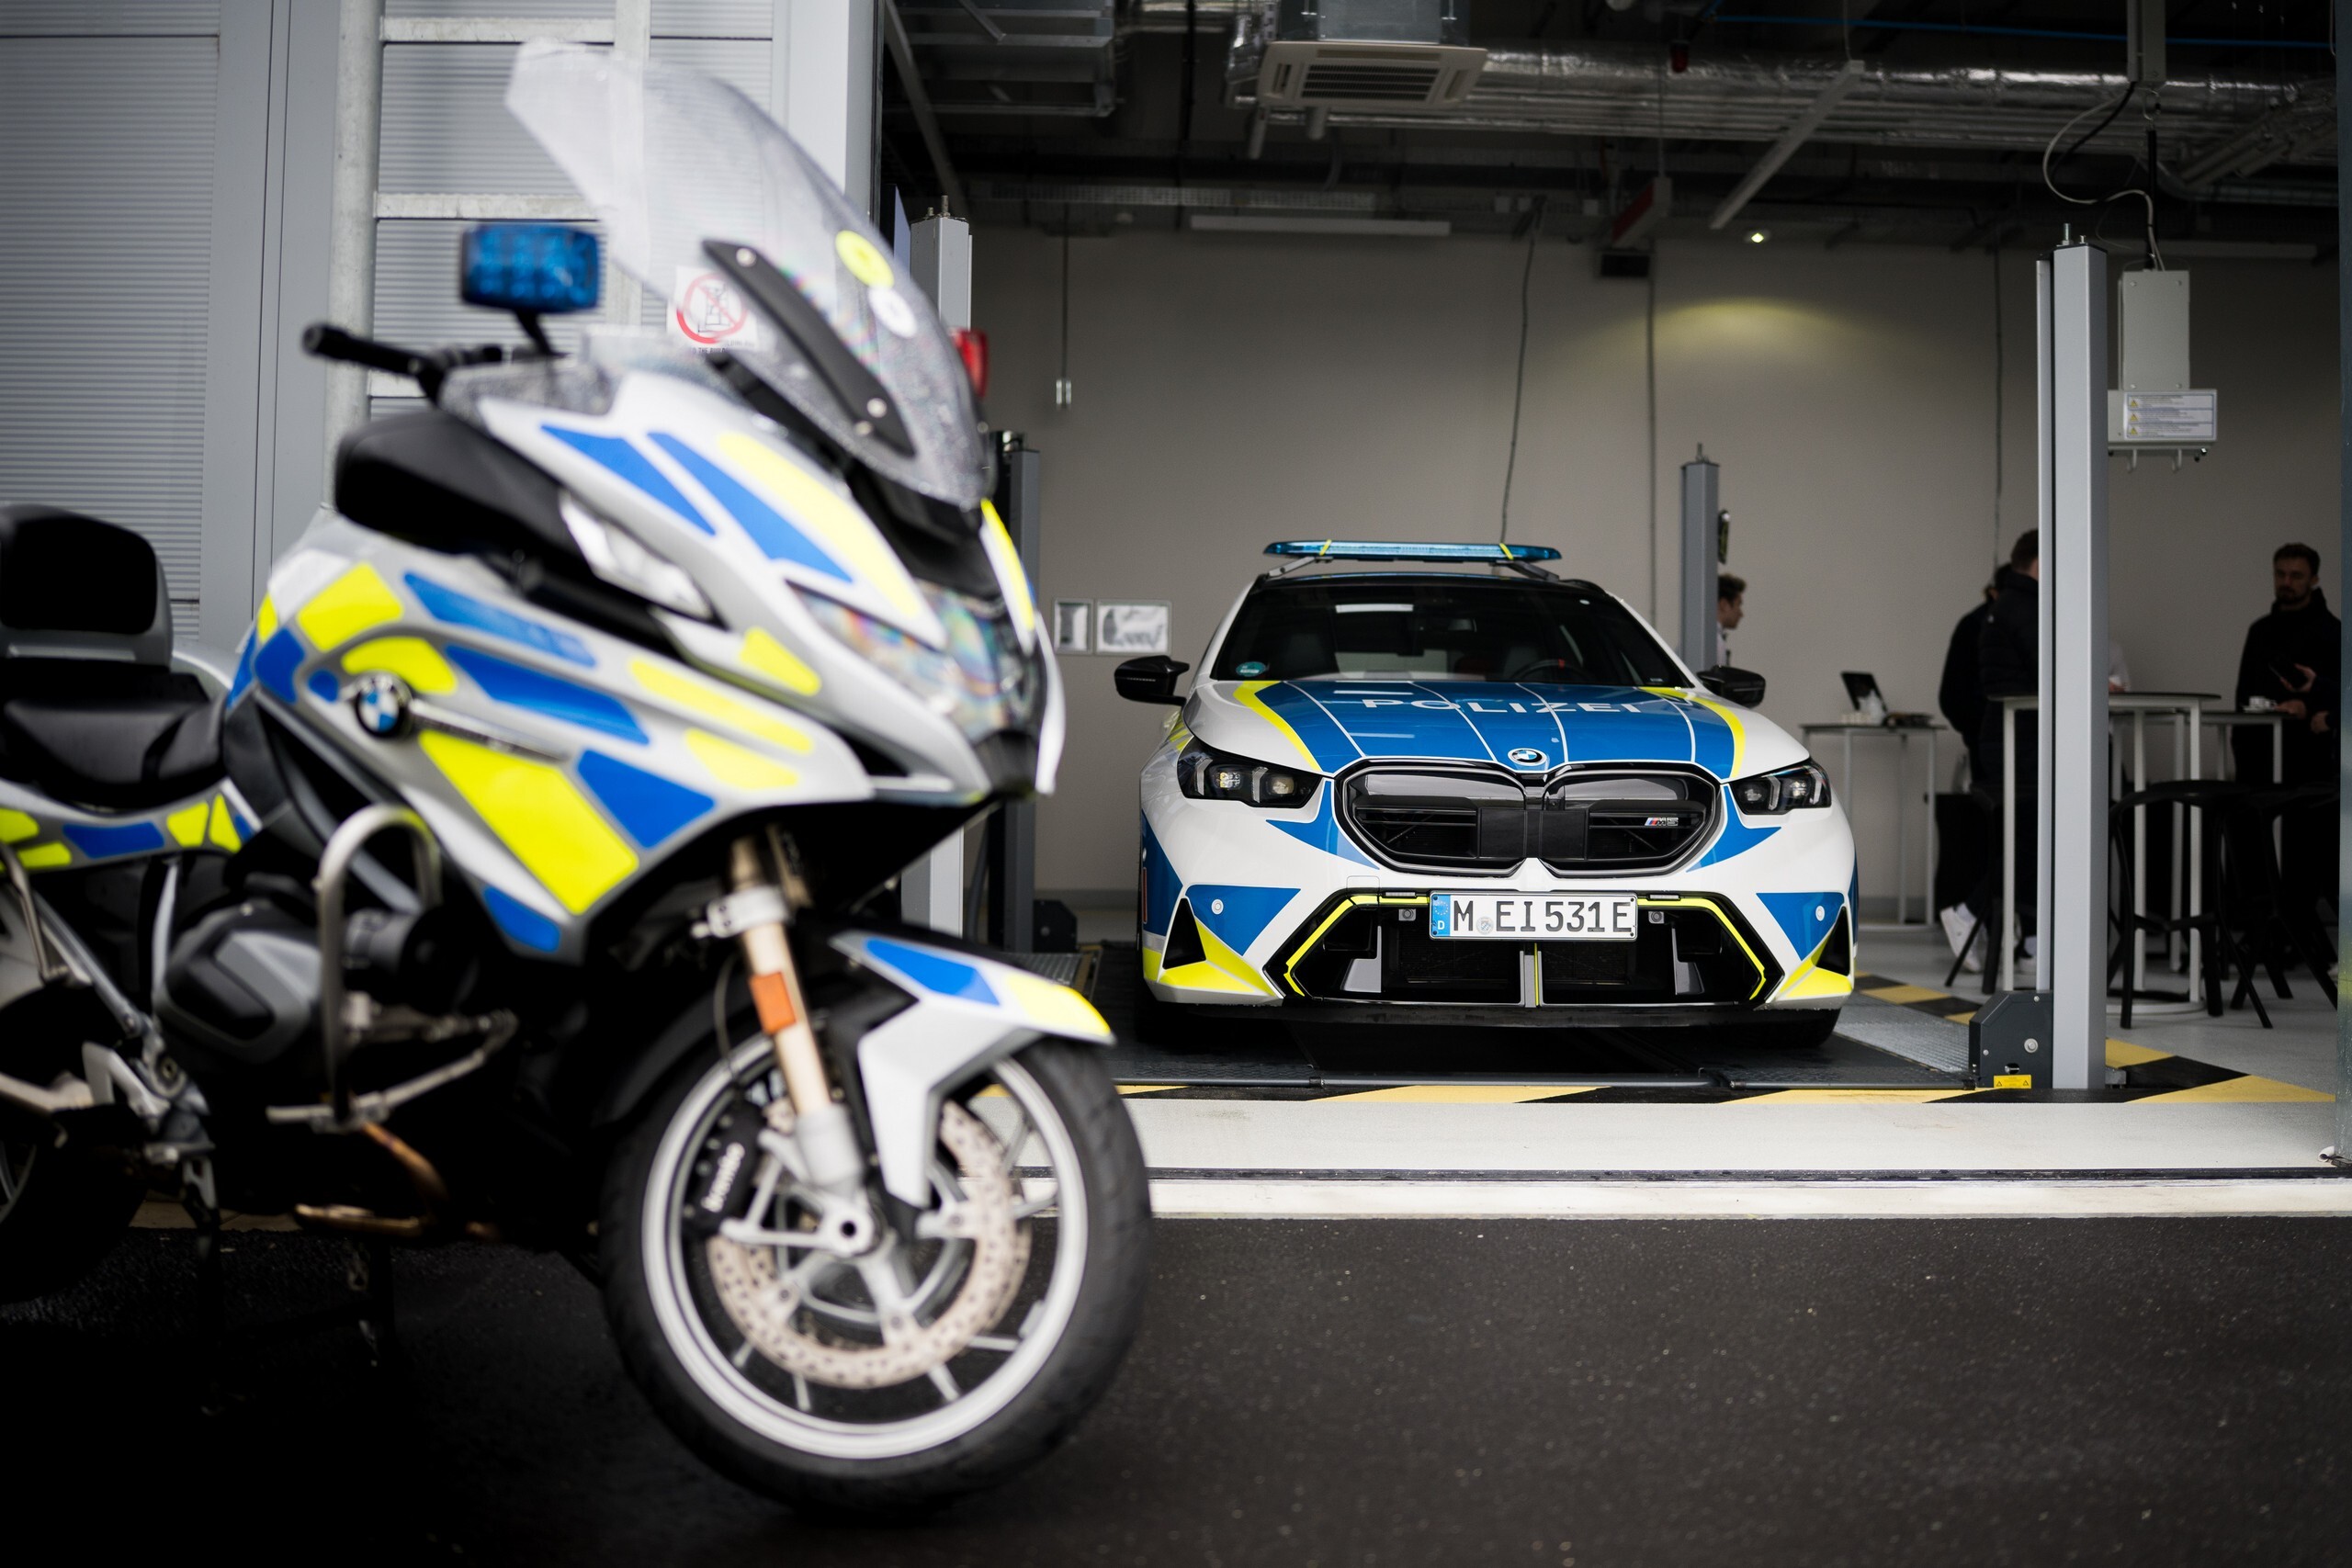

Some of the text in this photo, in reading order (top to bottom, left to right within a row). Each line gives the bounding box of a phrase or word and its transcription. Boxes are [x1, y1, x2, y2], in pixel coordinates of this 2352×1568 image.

[1362, 699, 1641, 714] POLIZEI
[1453, 900, 1474, 931] M
[1496, 900, 1536, 932] EI
[1437, 919, 1445, 931] D
